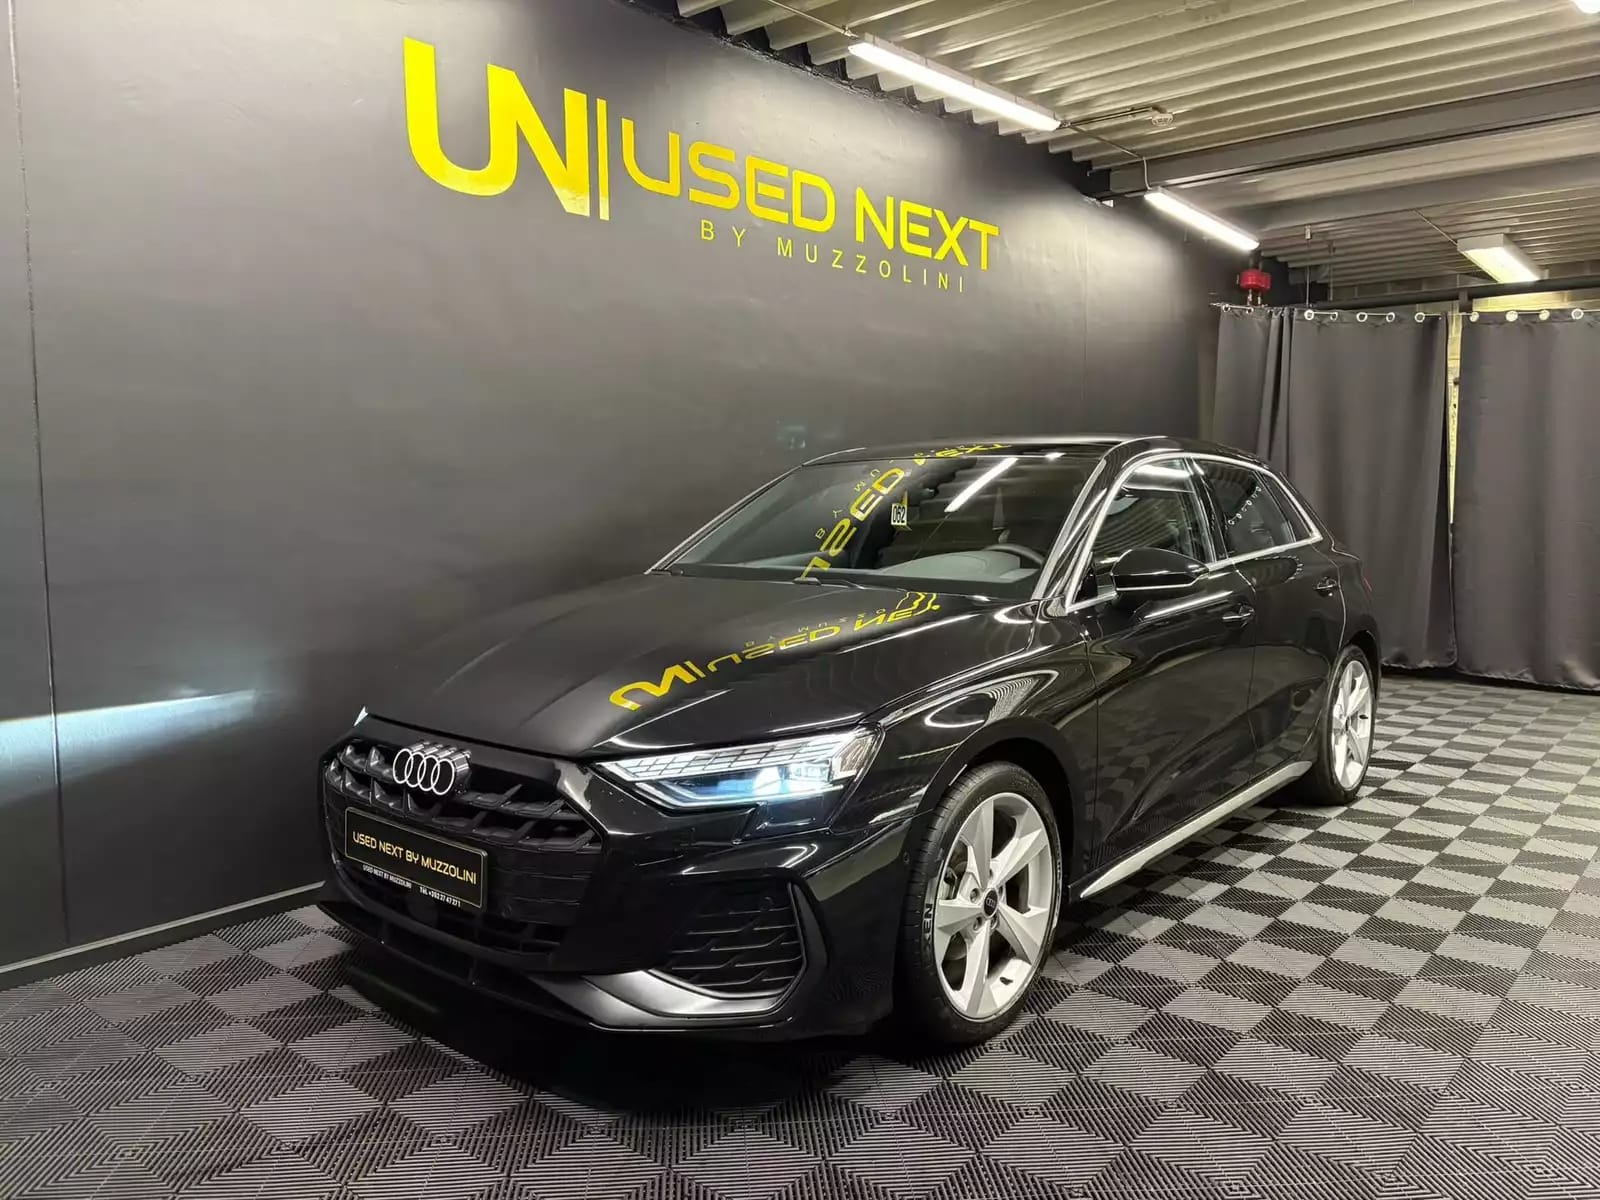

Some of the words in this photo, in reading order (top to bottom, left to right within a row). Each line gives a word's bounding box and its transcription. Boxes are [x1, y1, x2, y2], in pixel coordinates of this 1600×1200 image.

[621, 117, 836, 233] USED
[855, 186, 999, 270] NEXT
[700, 219, 746, 248] BY
[777, 236, 964, 293] MUZZOLINI
[892, 505, 906, 524] 062
[352, 831, 377, 849] USED
[379, 841, 403, 859] NEXT
[405, 849, 419, 864] BY
[421, 855, 477, 885] MUZZOLINI
